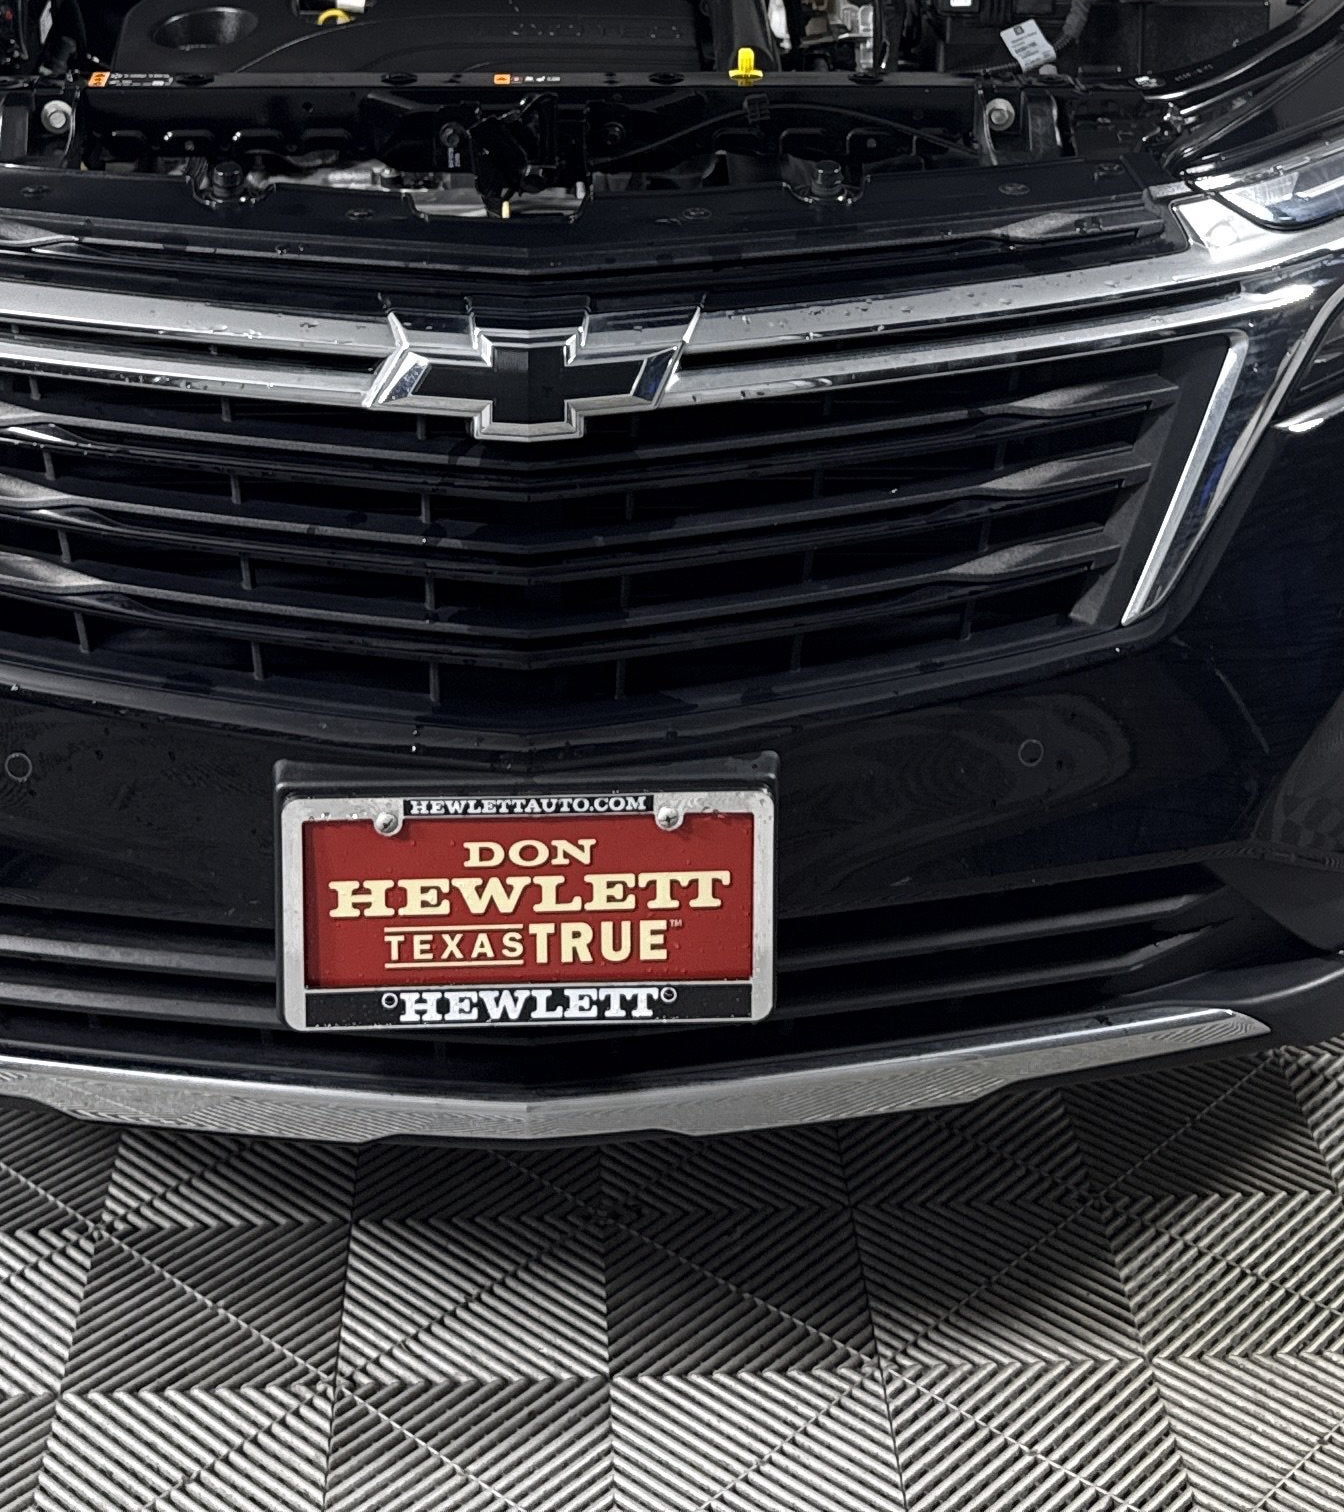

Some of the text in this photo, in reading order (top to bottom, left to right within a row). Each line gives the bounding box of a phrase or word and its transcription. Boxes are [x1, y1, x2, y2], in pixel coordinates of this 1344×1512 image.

[409, 796, 647, 816] HEWLETTAUTO.COM
[463, 838, 597, 869] DON
[328, 870, 731, 918] HEWLETT
[398, 988, 659, 1023] HEWLETT
